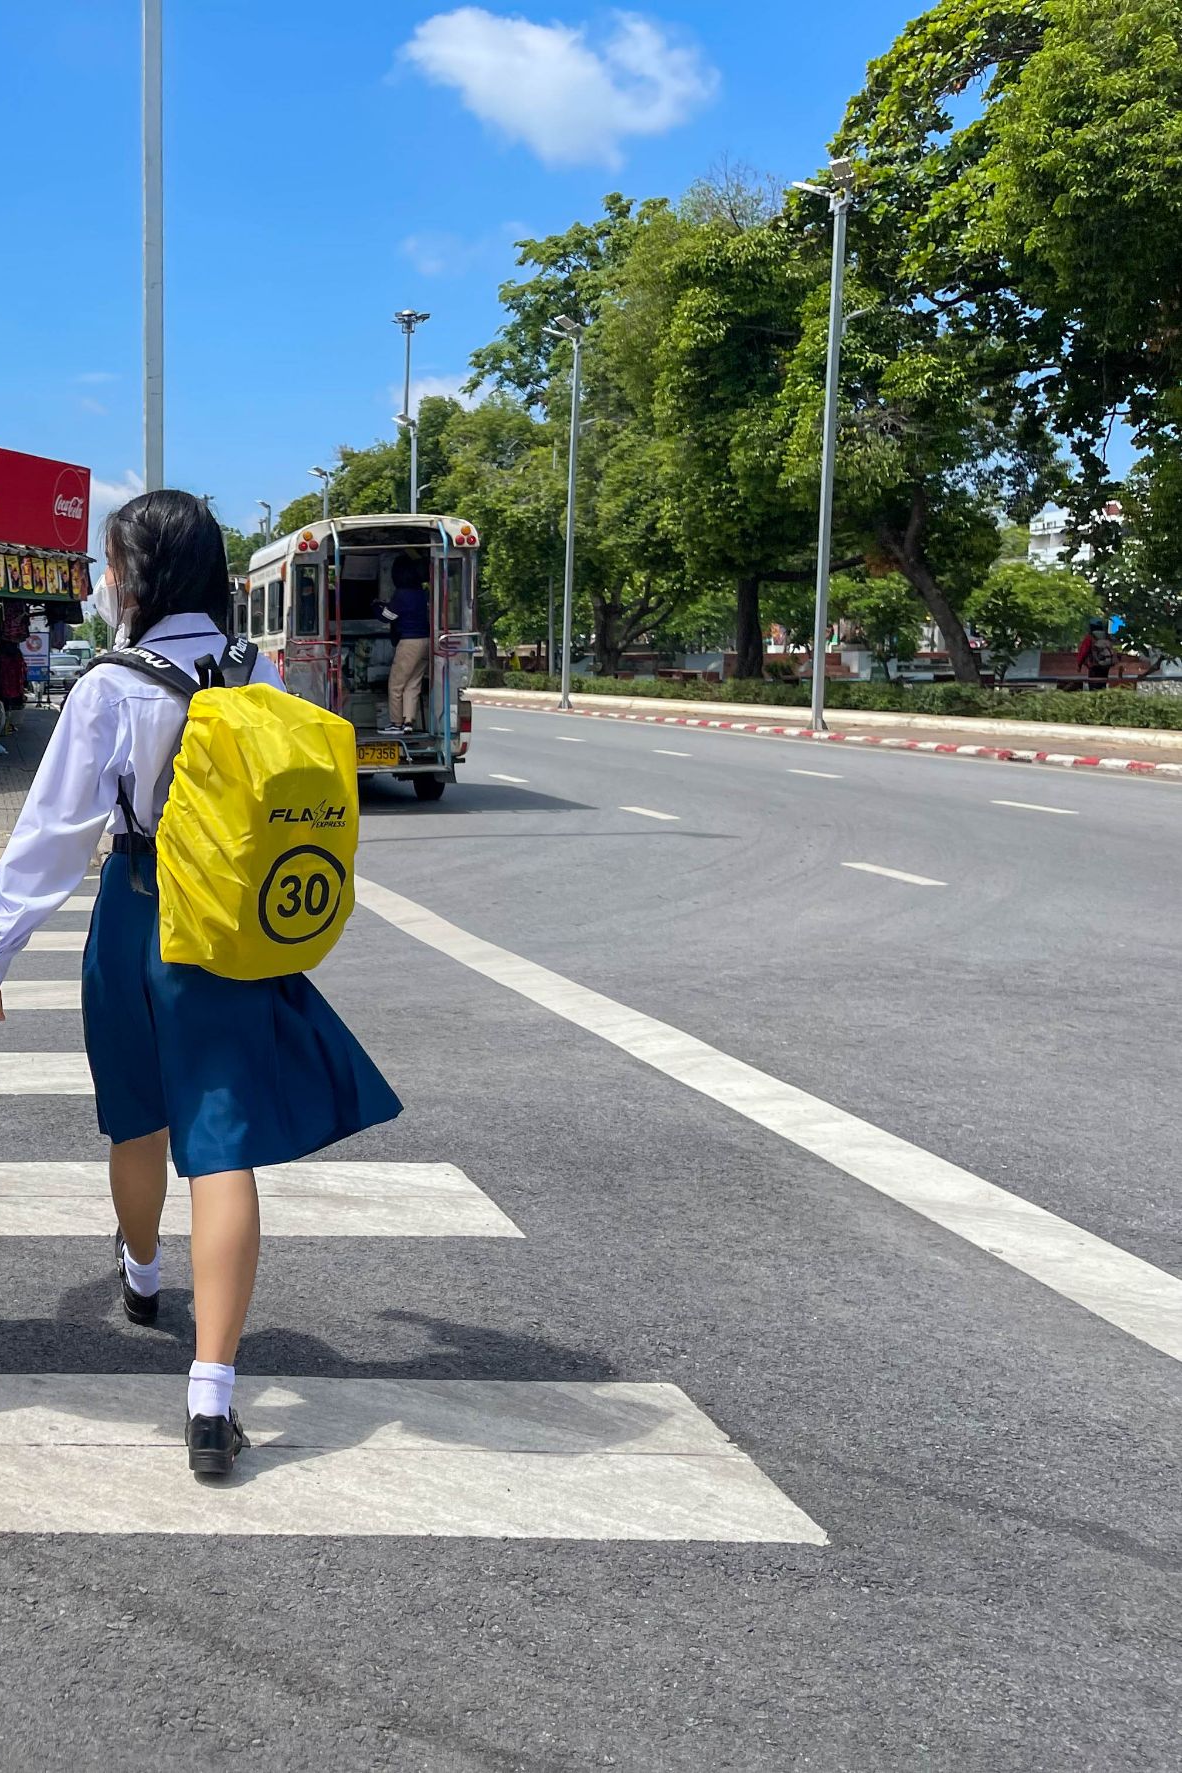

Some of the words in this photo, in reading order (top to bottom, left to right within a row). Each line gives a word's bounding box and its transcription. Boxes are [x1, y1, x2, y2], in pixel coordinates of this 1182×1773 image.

[358, 747, 396, 760] 0-7356
[316, 821, 346, 829] EXPRESS
[277, 873, 330, 918] 30
